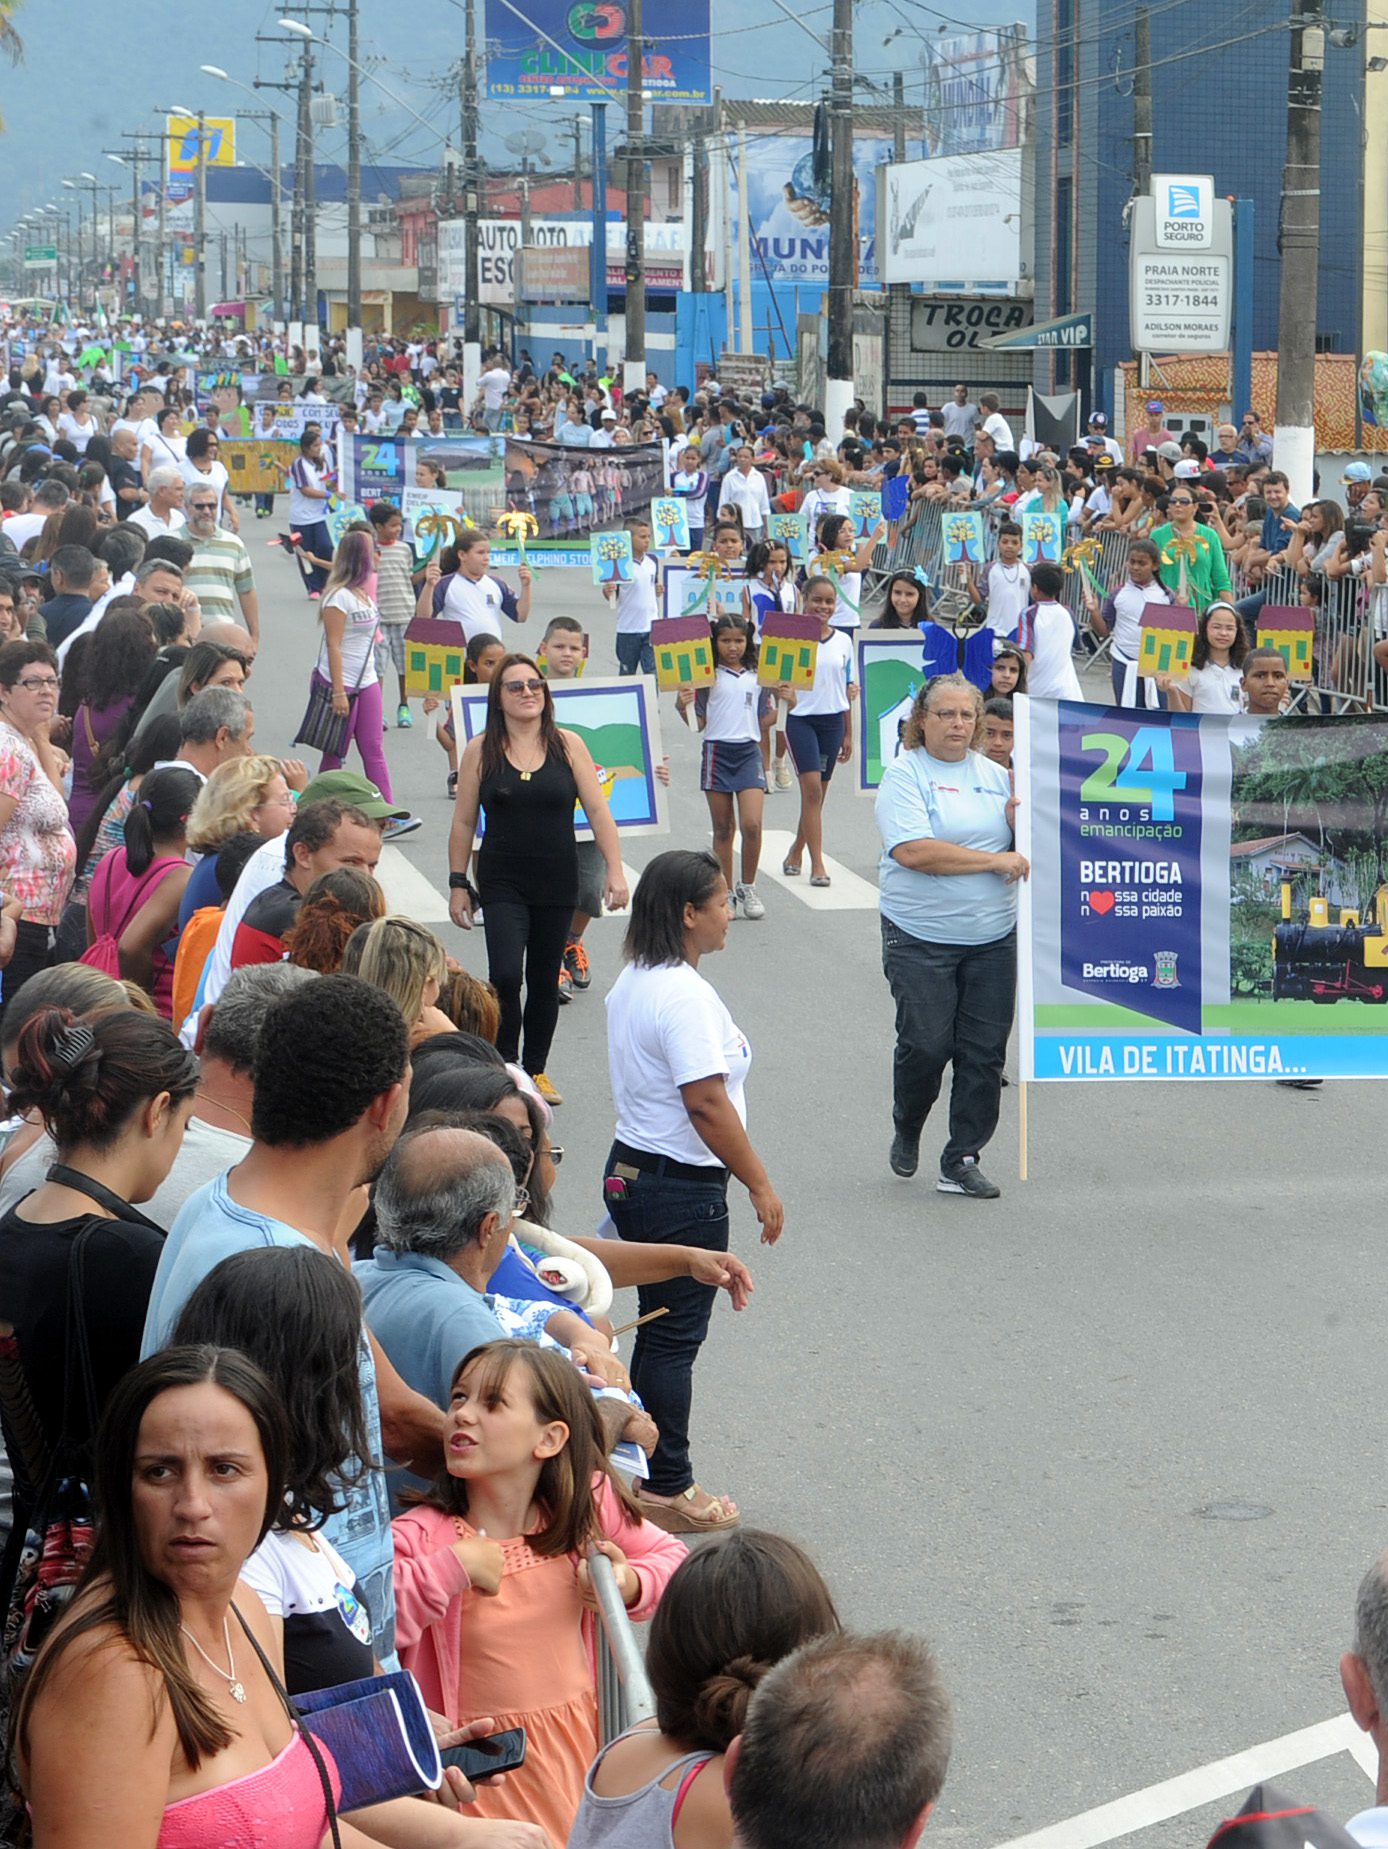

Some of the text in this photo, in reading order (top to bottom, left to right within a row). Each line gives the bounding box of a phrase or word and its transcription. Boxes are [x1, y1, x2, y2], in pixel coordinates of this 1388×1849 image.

[1164, 221, 1205, 232] PORTO
[1164, 232, 1204, 241] SEGURO
[477, 226, 518, 250] AUTO
[1145, 265, 1220, 276] PRAIA NORTE
[923, 303, 1026, 327] TROCA
[1060, 324, 1088, 345] VIP
[1144, 323, 1182, 331] ADILSON
[361, 442, 400, 476] 24
[1080, 727, 1187, 821] 24
[1080, 807, 1150, 821] anos
[1080, 821, 1183, 842] emancipação
[1080, 860, 1183, 884] BERTIOGA
[1142, 887, 1183, 903] cidade
[1142, 902, 1183, 920] paixão
[1083, 962, 1149, 983] Bertioga
[1059, 1044, 1307, 1074] VILA DE ITATINGA...
